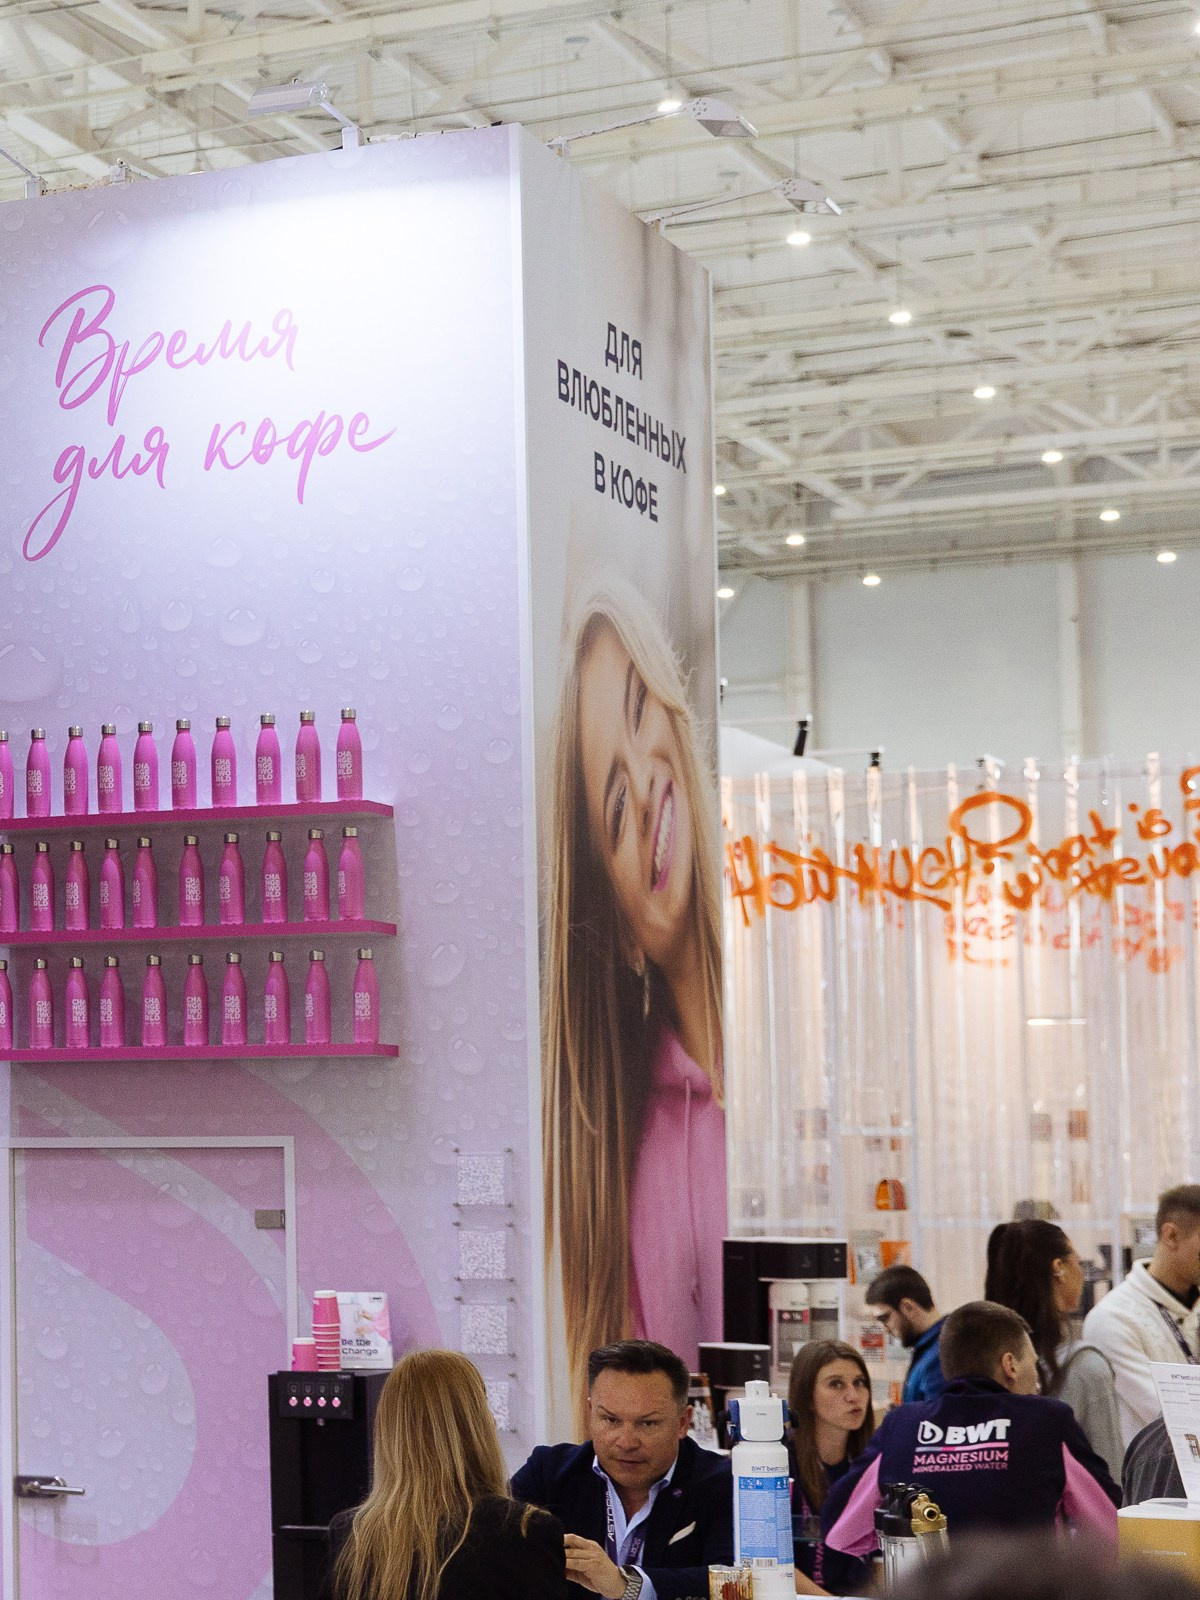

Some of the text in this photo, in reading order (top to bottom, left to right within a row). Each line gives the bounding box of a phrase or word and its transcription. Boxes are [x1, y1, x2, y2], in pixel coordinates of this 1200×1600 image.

[38, 284, 299, 427] Время
[605, 321, 643, 381] ДЛЯ
[557, 358, 687, 474] ВЛЮБЛЕННЫХ
[22, 410, 398, 562] для кофе
[594, 450, 658, 523] В КОФЕ
[913, 1450, 1009, 1466] MAGNESIUM
[944, 1418, 1012, 1445] BWT
[912, 1462, 1009, 1475] MINERALIZED WATER
